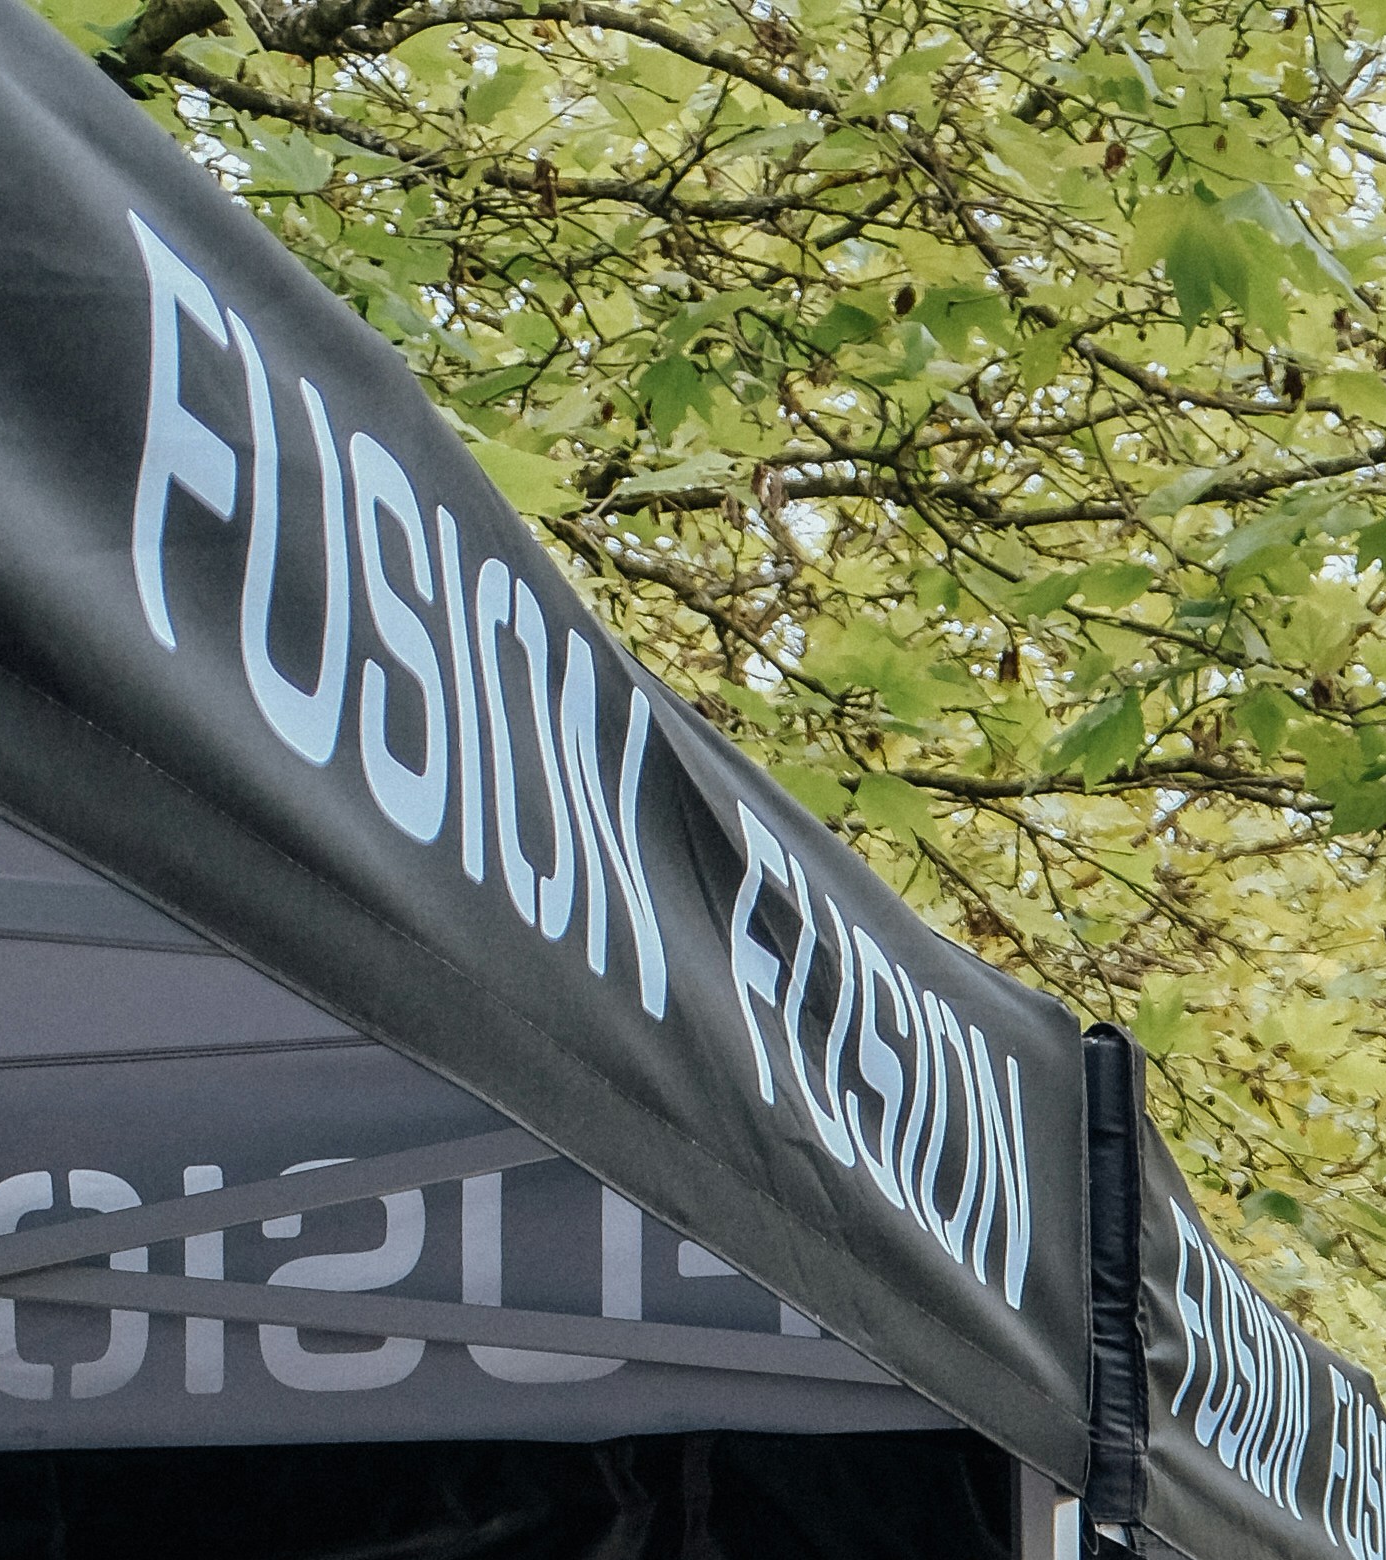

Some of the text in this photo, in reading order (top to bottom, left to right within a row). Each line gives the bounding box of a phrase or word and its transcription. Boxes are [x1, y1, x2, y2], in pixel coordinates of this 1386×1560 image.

[128, 208, 666, 1023] FUSION
[731, 800, 1030, 1310] FUSION
[1169, 1195, 1313, 1521] FUSION
